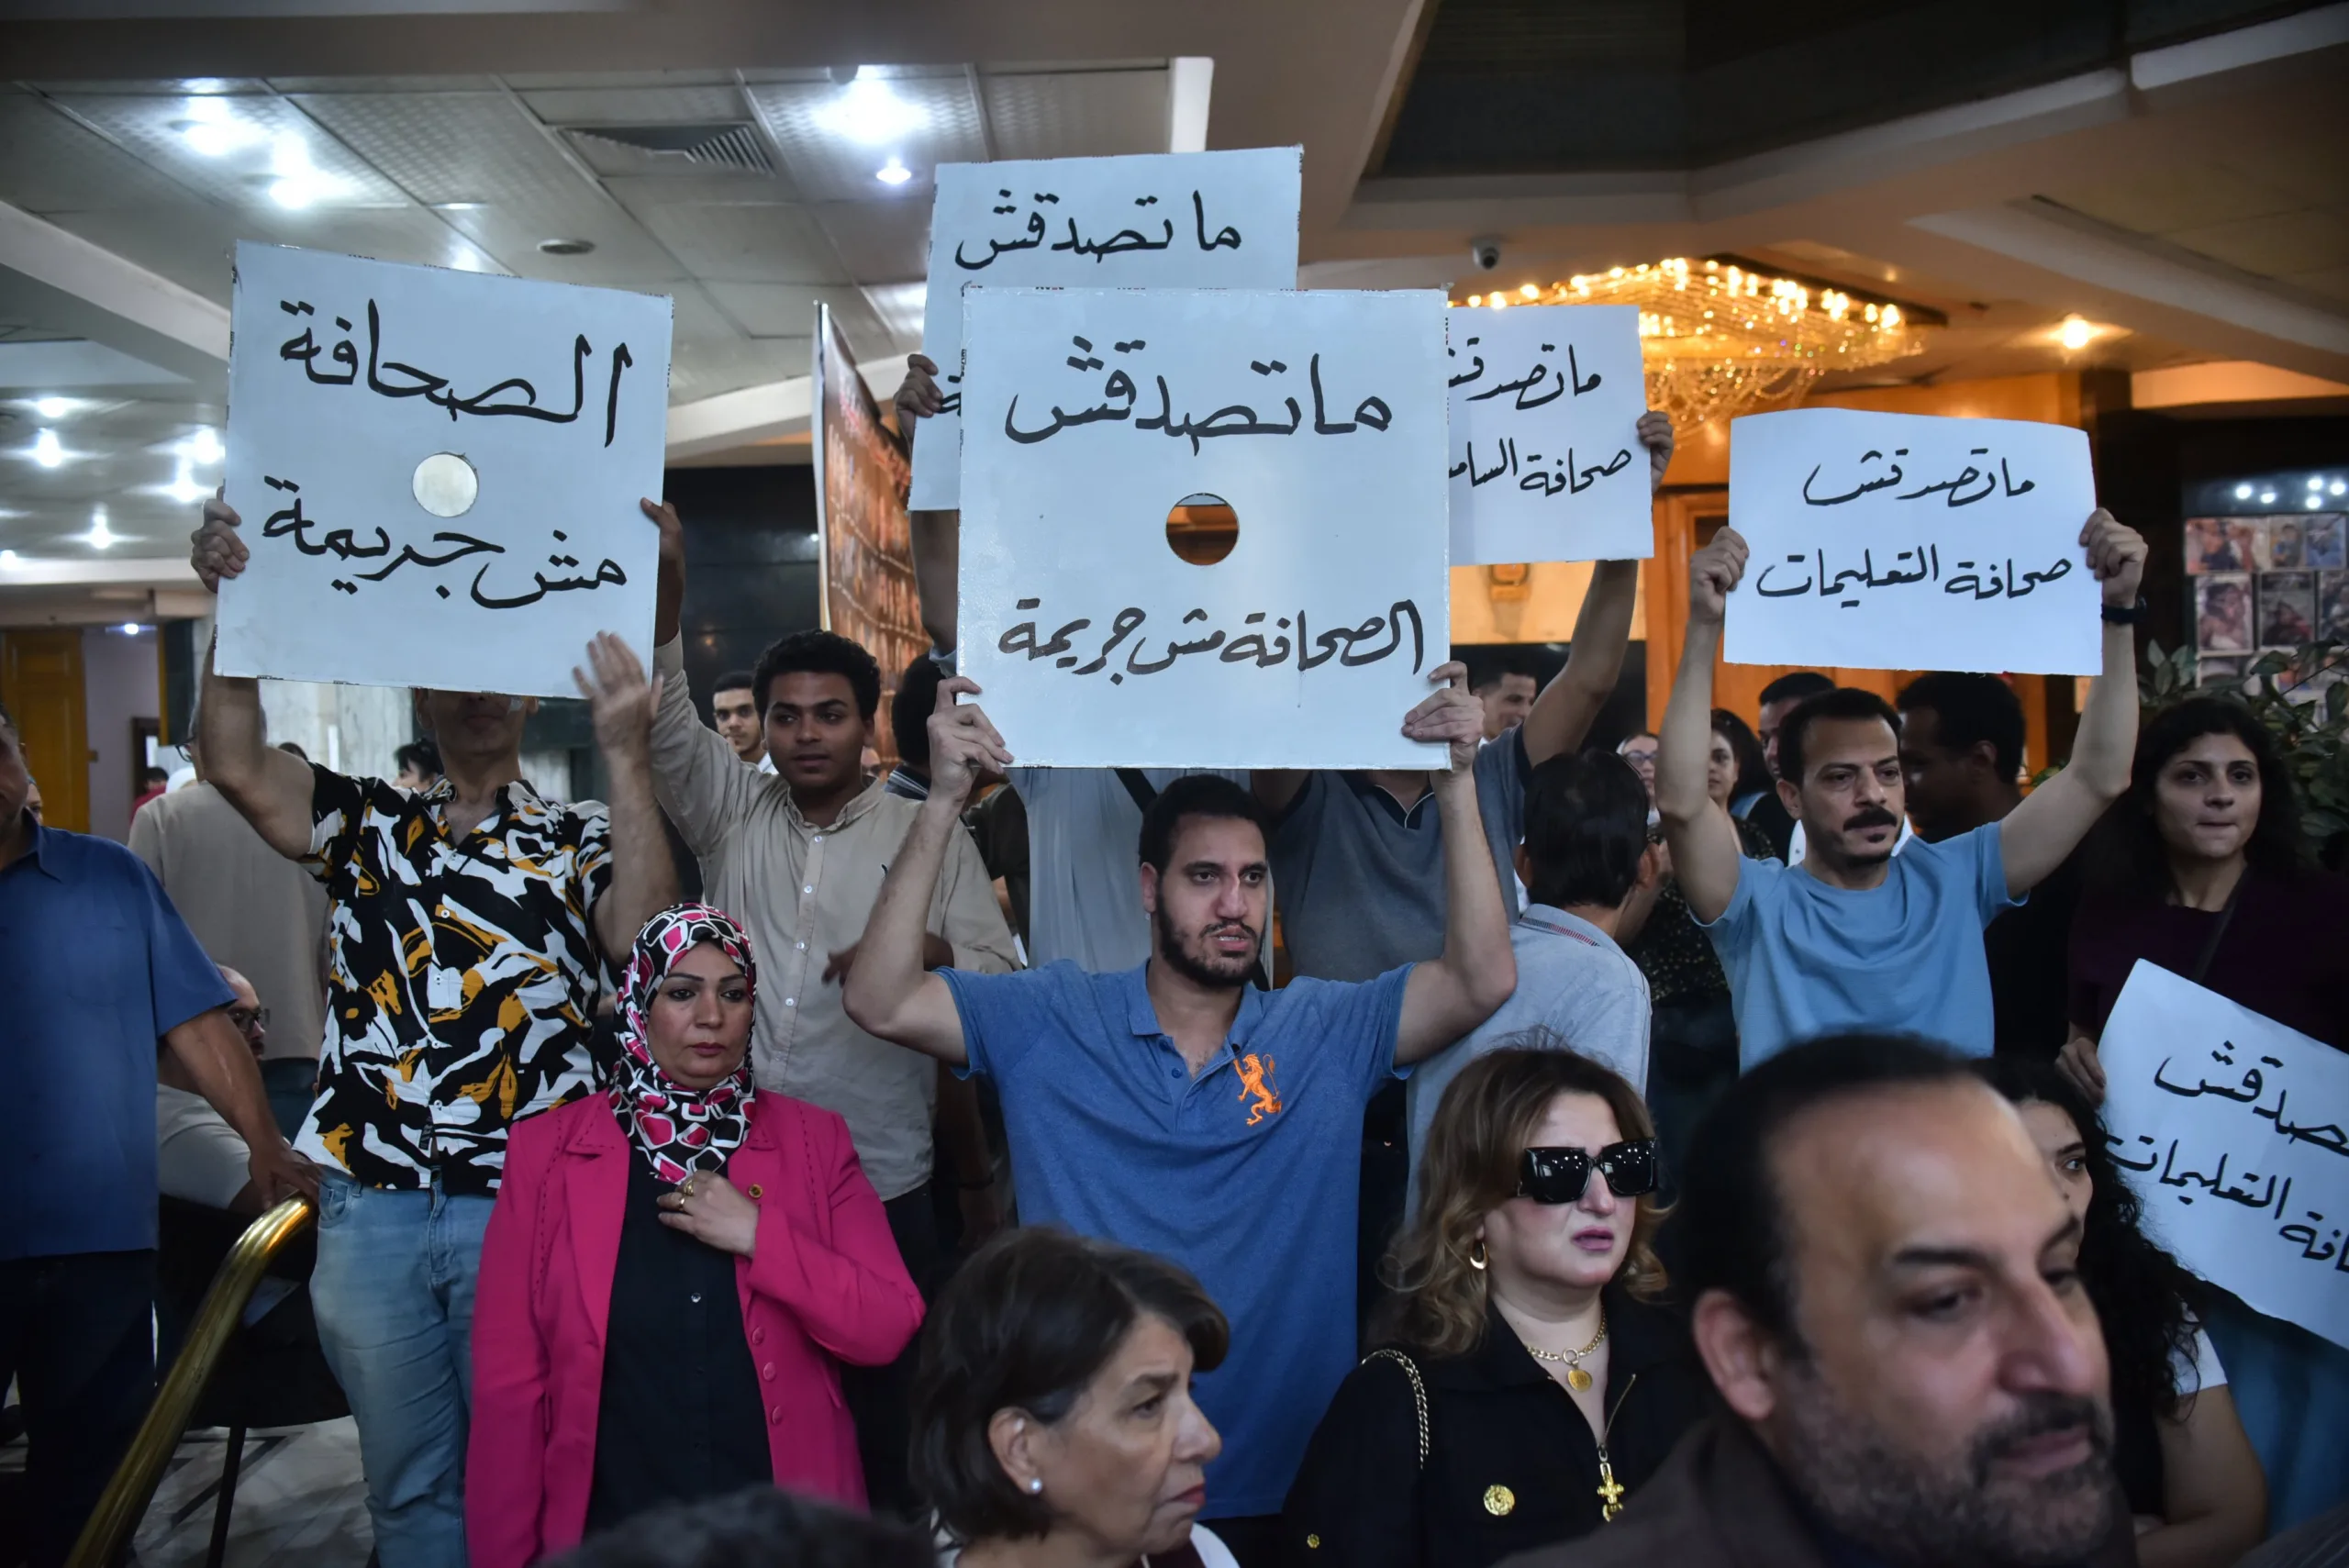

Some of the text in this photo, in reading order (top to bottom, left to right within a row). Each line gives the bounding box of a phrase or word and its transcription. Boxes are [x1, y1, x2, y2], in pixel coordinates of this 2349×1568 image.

[279, 298, 633, 448] الصحافة
[1520, 447, 1632, 497] صحافة
[262, 475, 628, 610] مش جريمة
[1756, 542, 2073, 609] صحافة التعليمات
[998, 597, 1424, 685] الصحافة مش جريمة
[2105, 1132, 2292, 1220] التعليمات
